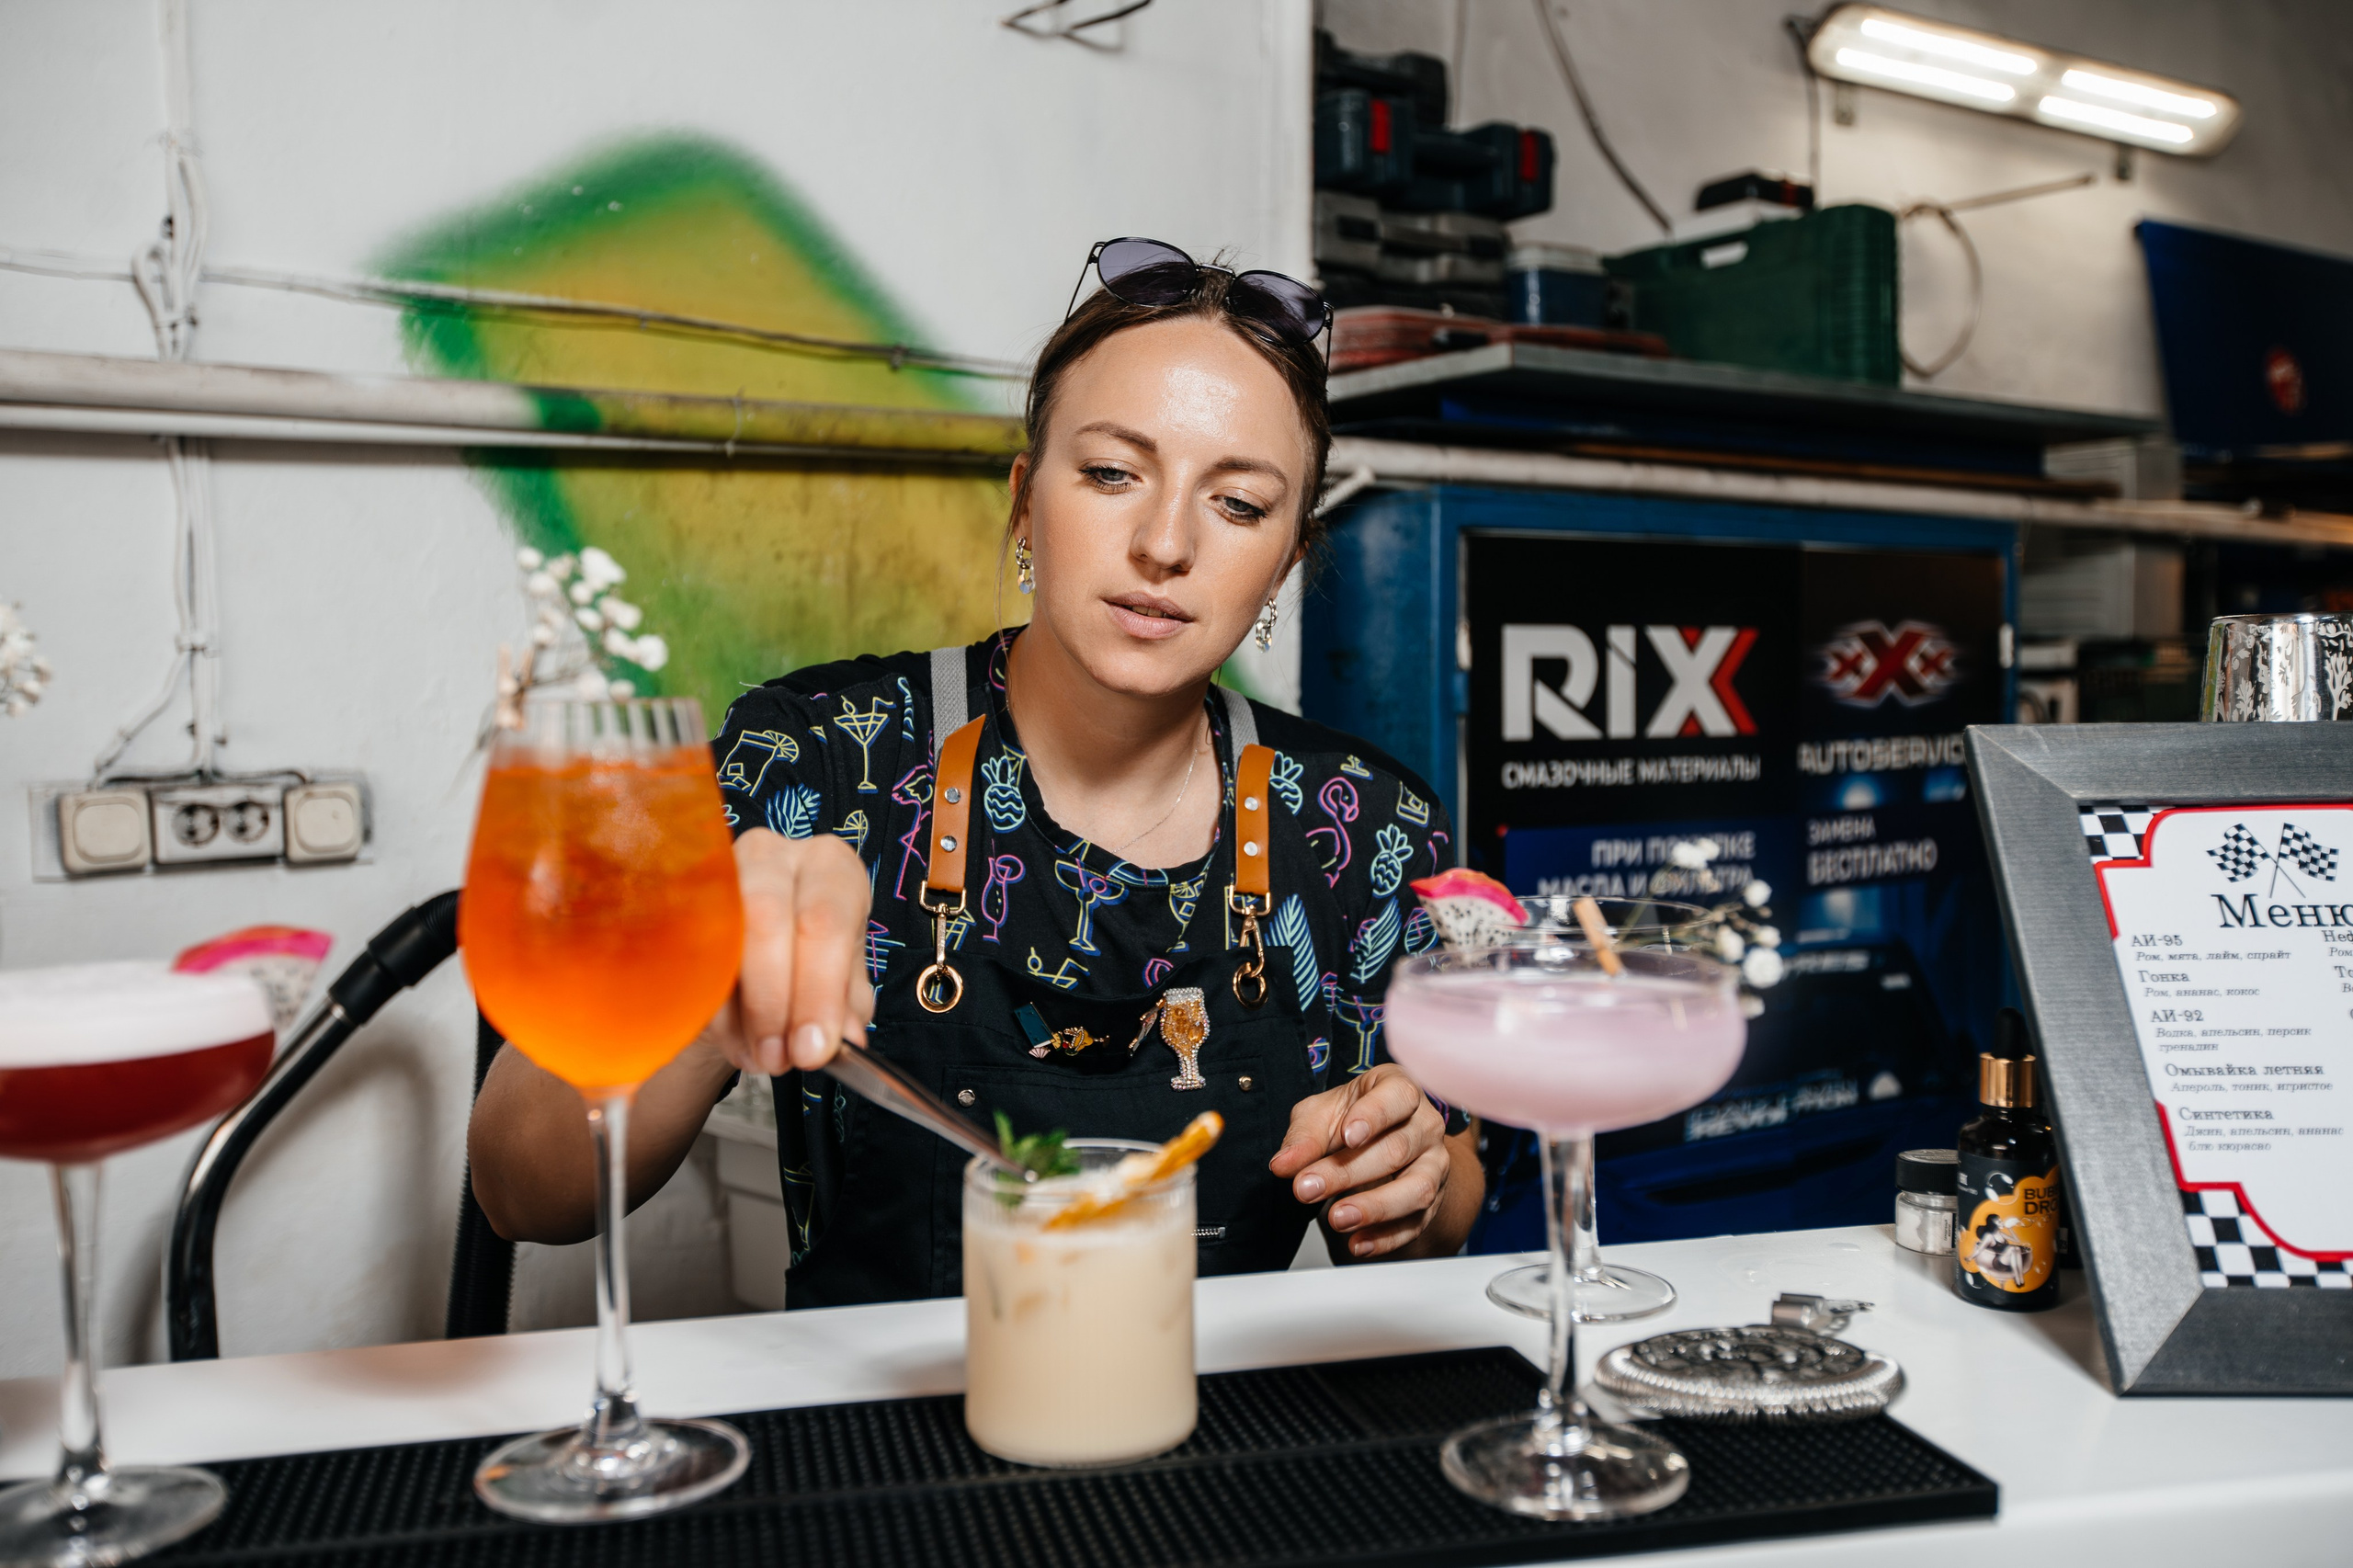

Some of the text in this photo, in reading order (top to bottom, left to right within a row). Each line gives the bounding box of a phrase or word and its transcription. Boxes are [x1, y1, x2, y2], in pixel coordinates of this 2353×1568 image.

[1502, 623, 1759, 741] RIX
[1501, 755, 1761, 789] СМАЗОЧНЫЕ МАТЕРИАЛЫ
[1807, 815, 1876, 846] ЗАМЕНА
[1591, 838, 1643, 868] ПРИ
[1807, 837, 1938, 884] БЕСПЛАТНО
[1627, 870, 1647, 897] И
[2211, 893, 2353, 928] Меню
[2136, 949, 2291, 961] Ром, мята, лайм, спрайт
[2138, 970, 2190, 983] Гонка
[2144, 987, 2260, 997] Ром, ананас, кокос
[2155, 1028, 2312, 1039] Водка, апельсин, персик
[2159, 1042, 2219, 1053] гренадин
[2165, 1062, 2325, 1076] Омывайка летняя
[2171, 1082, 2333, 1093] Апероль, тоник, игристое
[2178, 1107, 2275, 1120] Синтетика
[2185, 1126, 2344, 1137] Джин, апельсин, ананас
